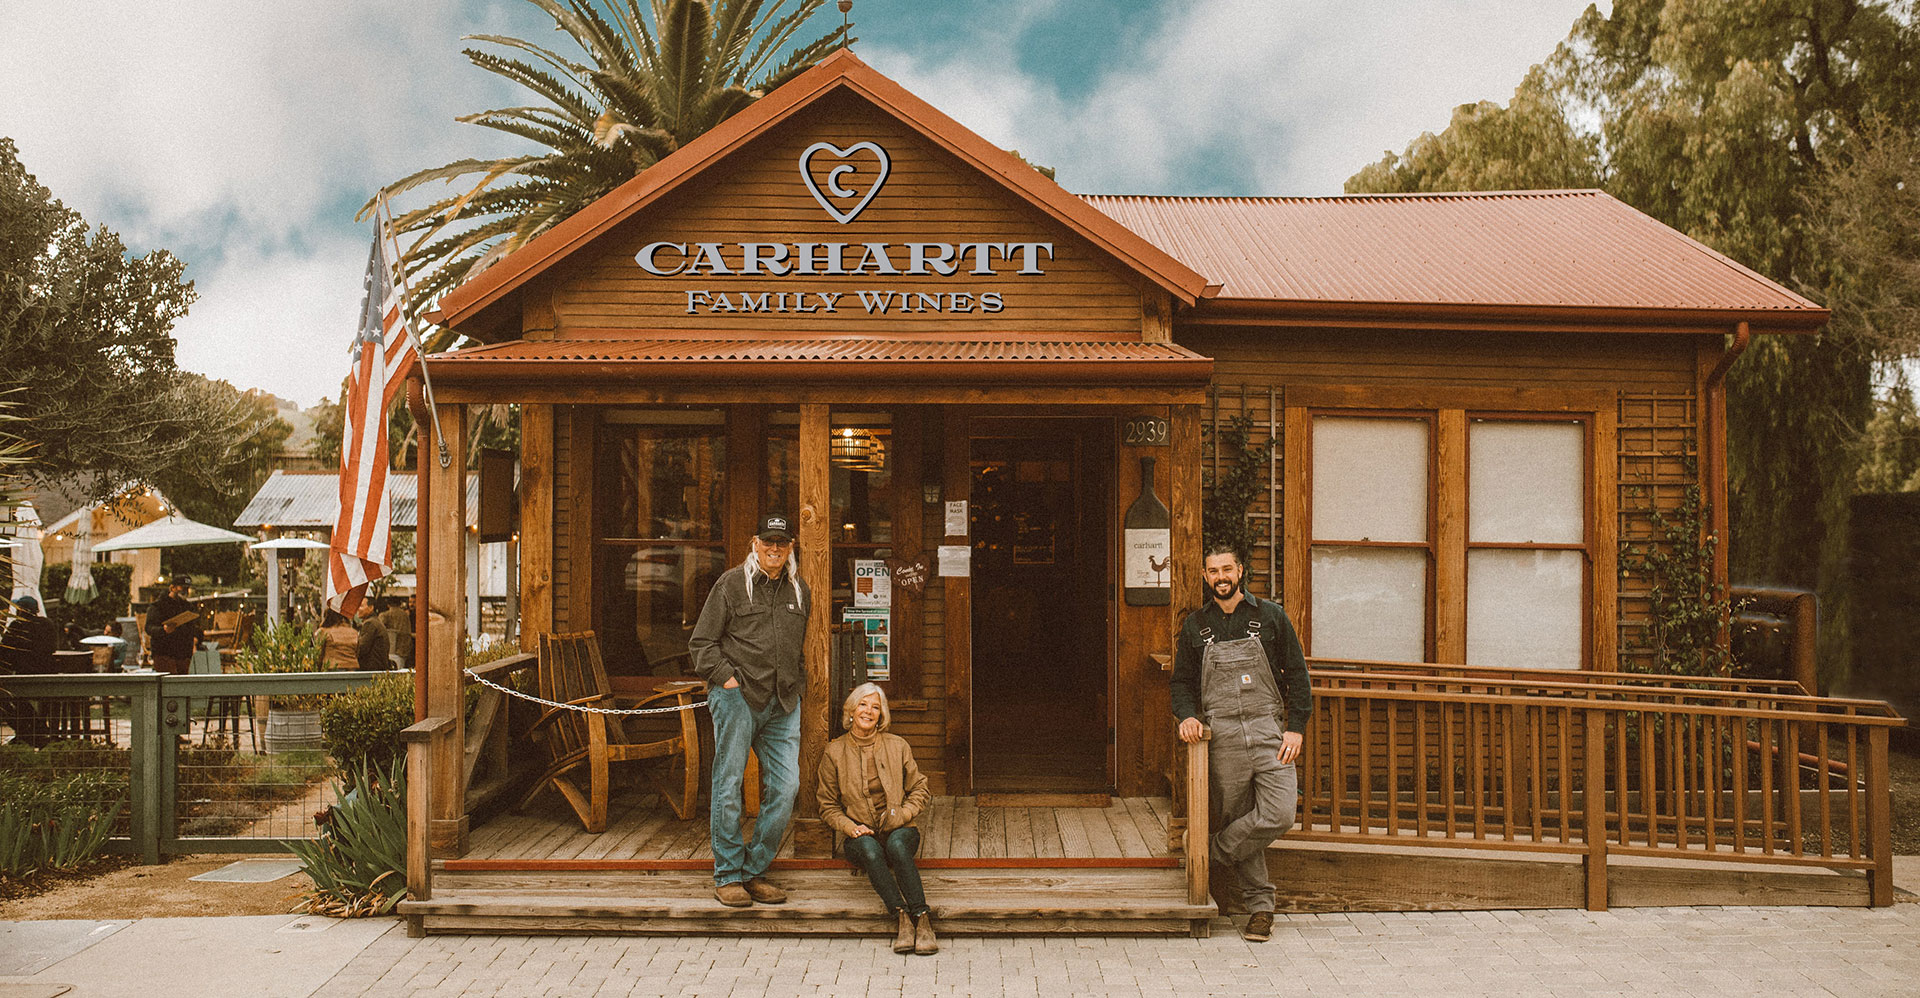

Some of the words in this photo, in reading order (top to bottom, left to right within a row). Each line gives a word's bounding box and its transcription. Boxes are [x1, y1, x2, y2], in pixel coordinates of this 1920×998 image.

[827, 164, 857, 198] C
[634, 241, 1054, 276] CARHARTT
[685, 290, 846, 314] FAMILY
[854, 290, 1006, 314] WINES
[1125, 421, 1167, 443] 2939
[856, 567, 890, 577] OPEN
[901, 575, 924, 586] OPEN
